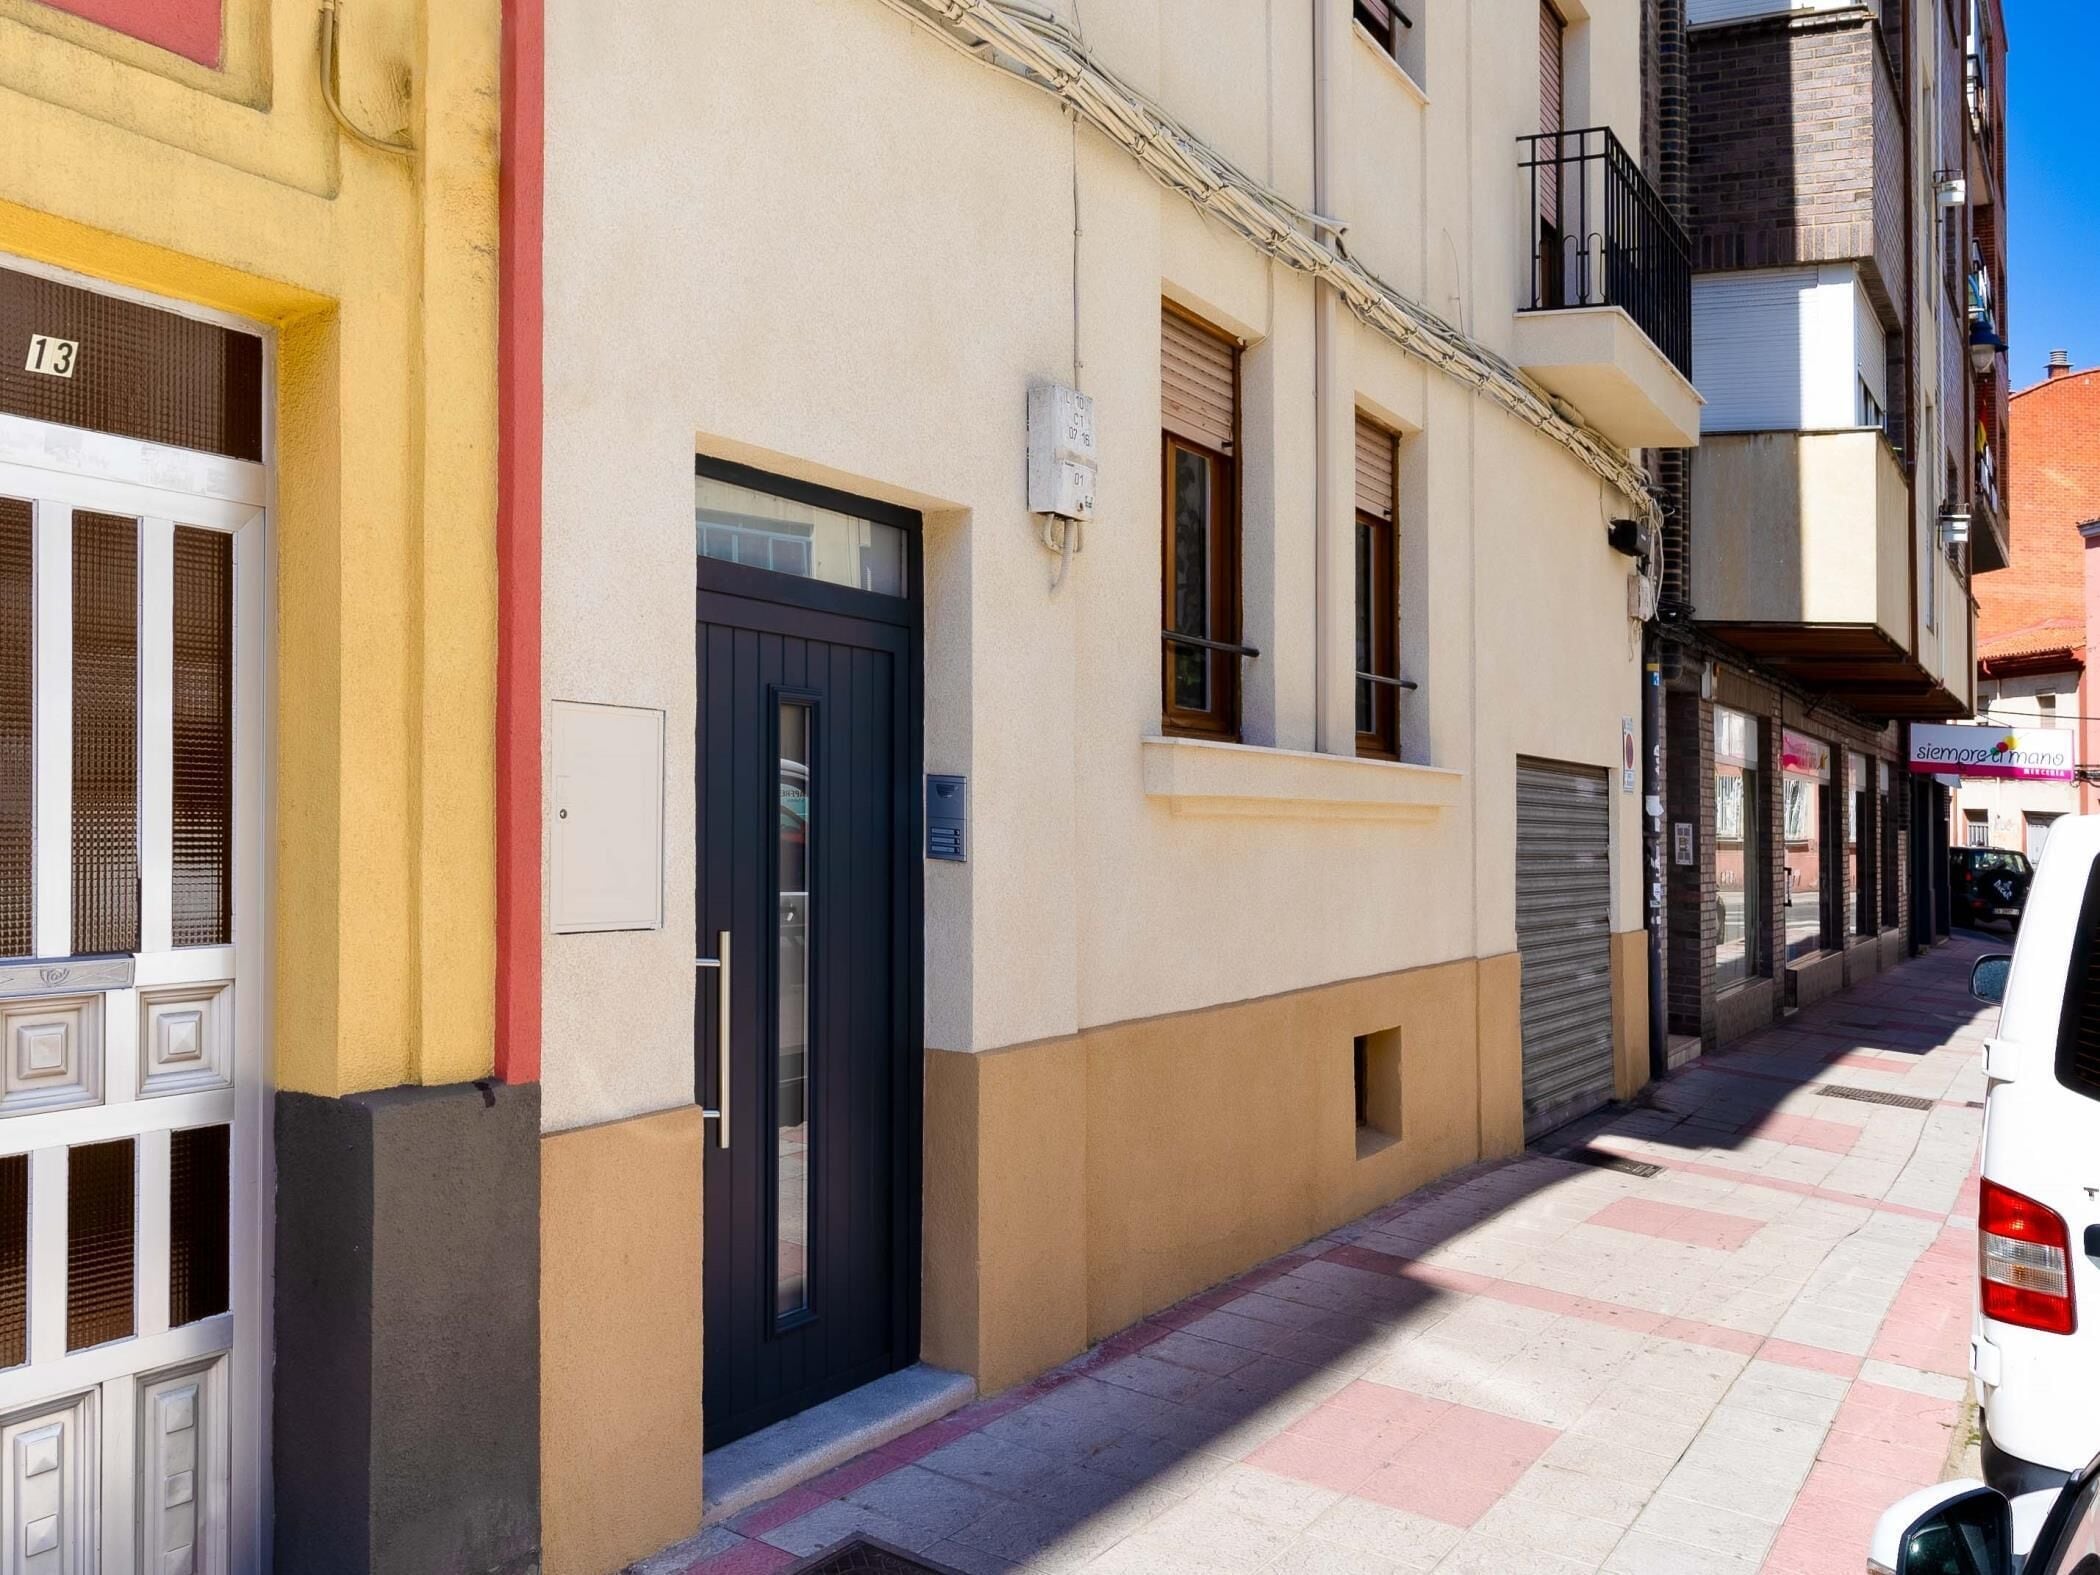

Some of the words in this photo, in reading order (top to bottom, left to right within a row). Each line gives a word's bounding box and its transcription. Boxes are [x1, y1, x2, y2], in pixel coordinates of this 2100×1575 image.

[35, 338, 73, 374] 13
[1916, 742, 1987, 768] siempre
[2008, 750, 2064, 766] mano
